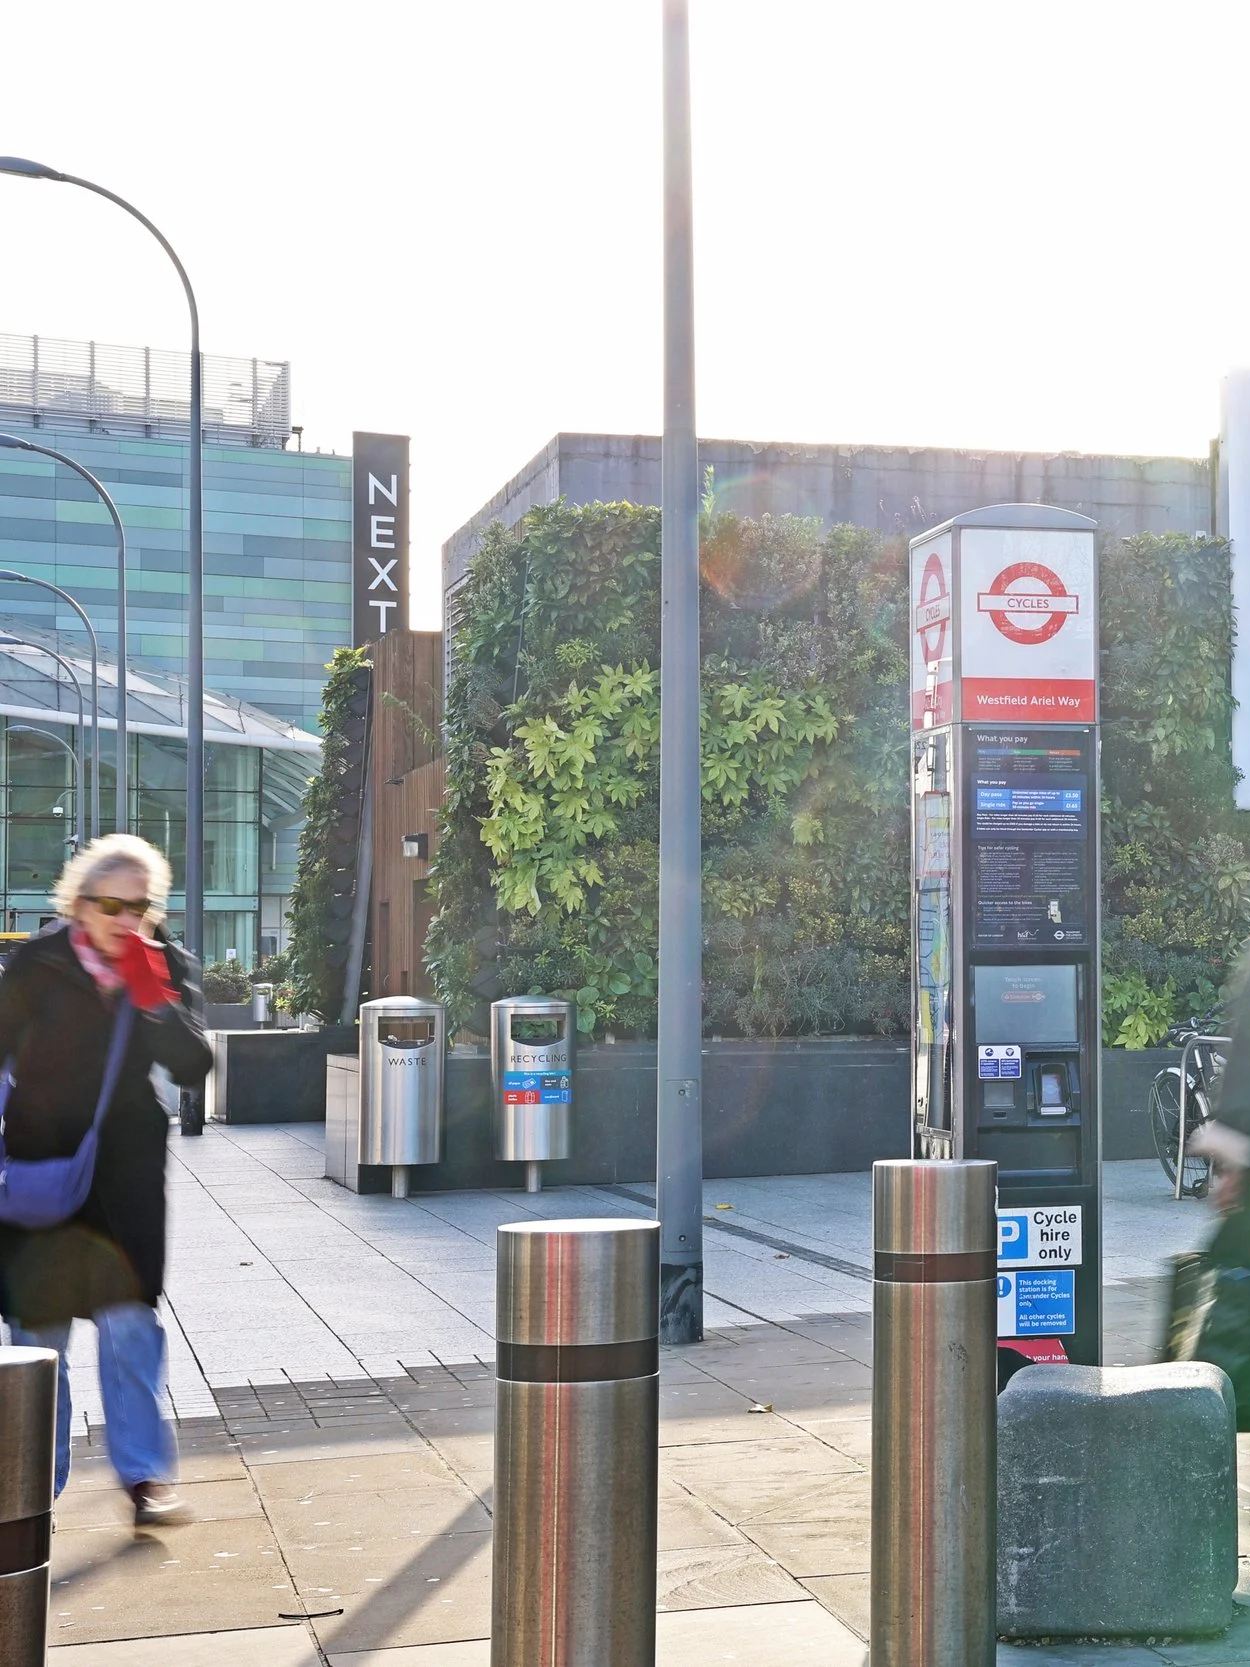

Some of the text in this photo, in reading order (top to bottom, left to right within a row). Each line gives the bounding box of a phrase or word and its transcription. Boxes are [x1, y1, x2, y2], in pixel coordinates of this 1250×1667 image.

[367, 472, 399, 633] NEXT
[1007, 598, 1050, 609] CYCLES
[976, 695, 1081, 708] Westfield Ariel Way
[977, 734, 1028, 744] What you pay
[388, 1057, 426, 1066] WASTE
[510, 1054, 567, 1063] RECYCLING
[1033, 1211, 1077, 1227] Cycle
[997, 1220, 1020, 1256] P
[1040, 1228, 1070, 1242] hire
[1038, 1245, 1072, 1261] only
[1050, 1292, 1070, 1300] Cycles
